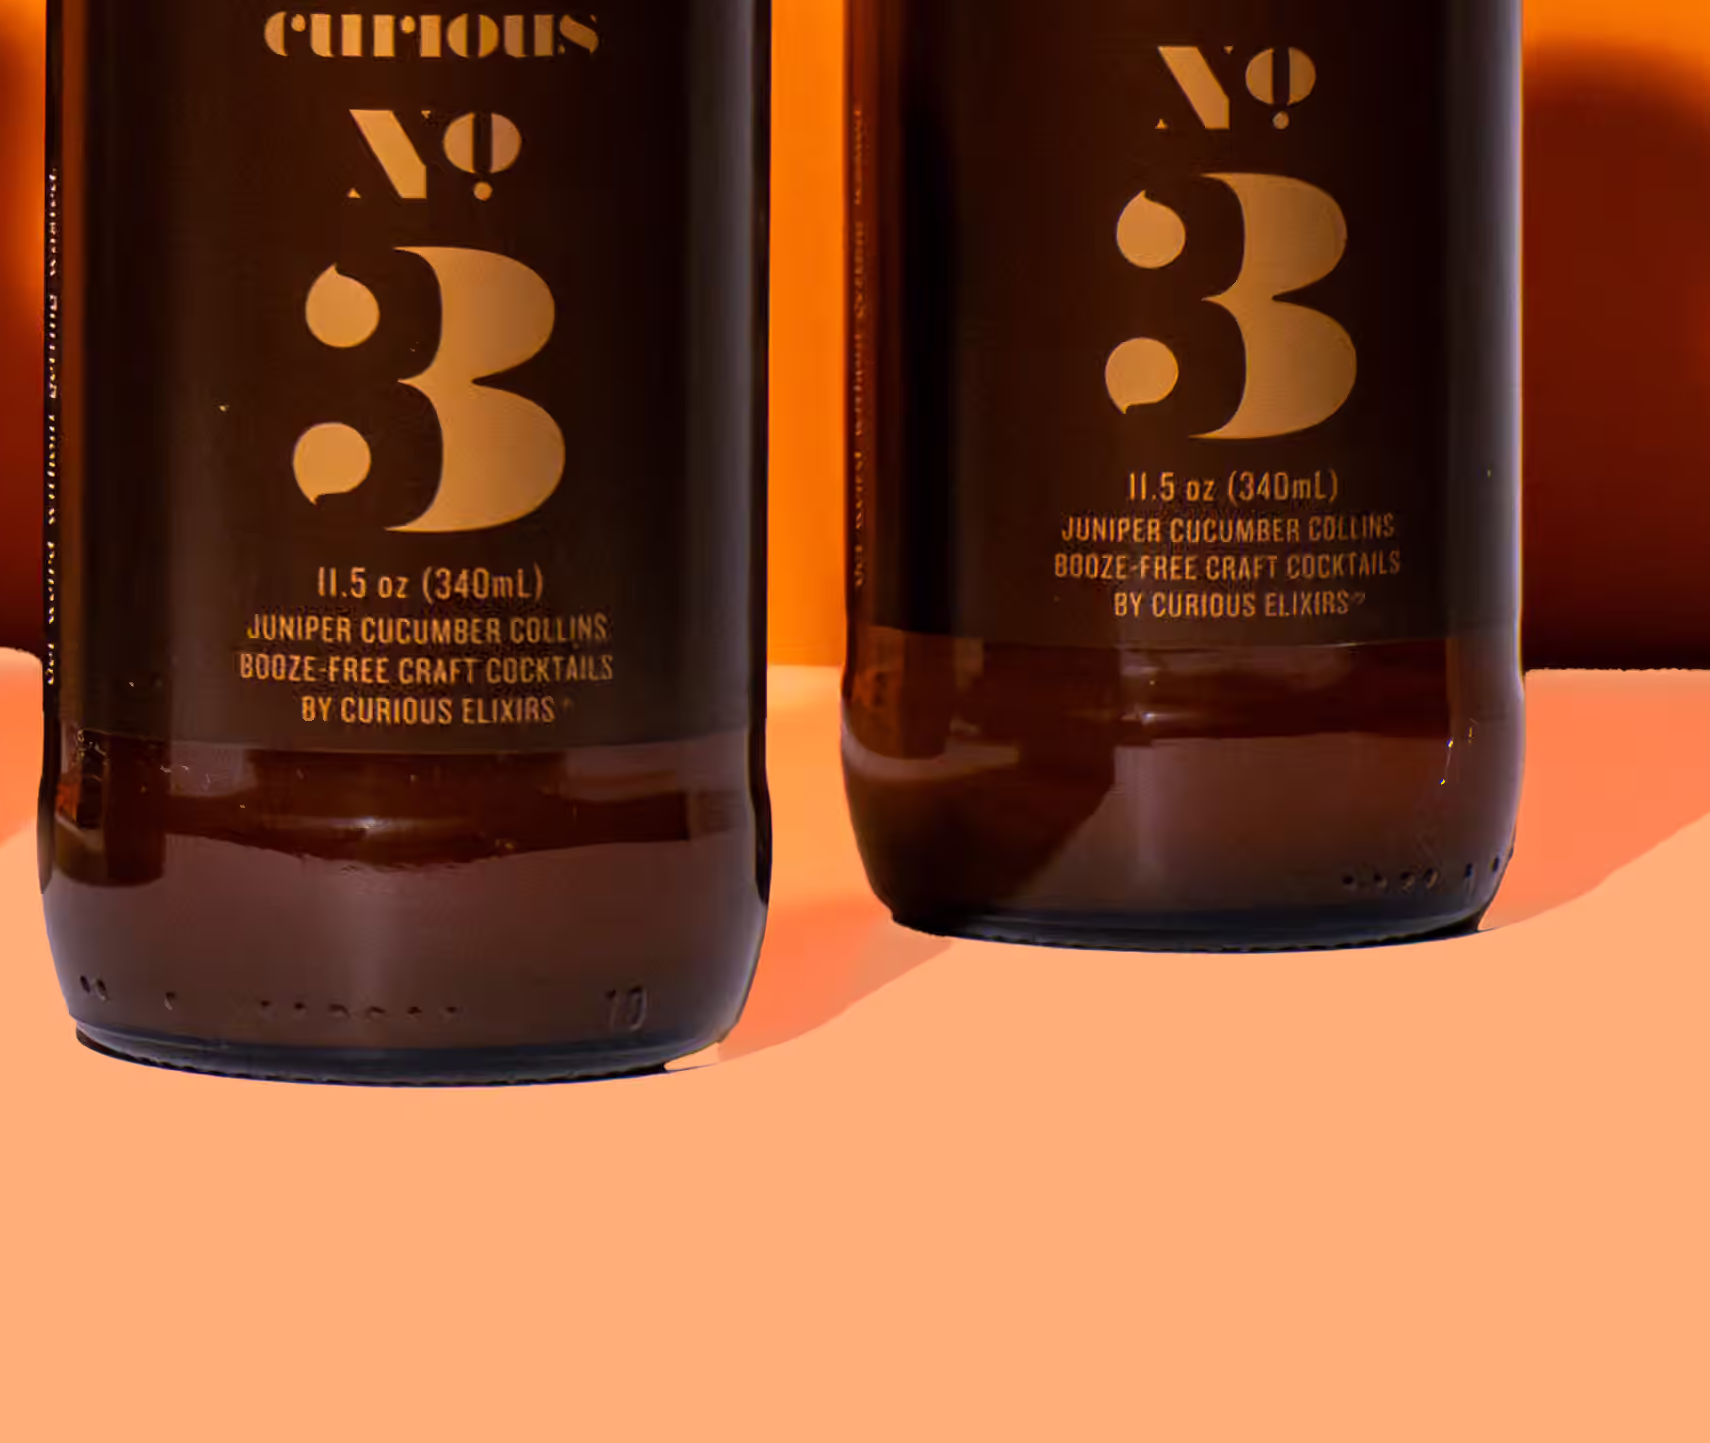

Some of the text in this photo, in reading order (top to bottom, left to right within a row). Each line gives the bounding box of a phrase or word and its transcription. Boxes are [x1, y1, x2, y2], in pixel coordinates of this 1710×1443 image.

[264, 11, 599, 58] curious
[1104, 172, 1358, 439] 3
[293, 246, 566, 533] 3
[1128, 471, 1175, 501] 11.5
[1186, 480, 1214, 501] oz
[1061, 513, 1395, 543] JUNIPER CUCUMBER COLLINS
[1054, 551, 1401, 582] BOOZE-FREE CRAFT COCKTAILS
[317, 566, 367, 598] 11.5
[378, 575, 409, 599] oz
[1114, 592, 1143, 617] BY
[1152, 592, 1256, 618] CURIOUS
[247, 613, 607, 645] JUNIPER CUCUMBER COLLINS
[240, 653, 613, 684] BOOZE-FREE CRAFT COCKTAILS
[301, 696, 331, 722] BY
[340, 697, 453, 725] CURIOUS
